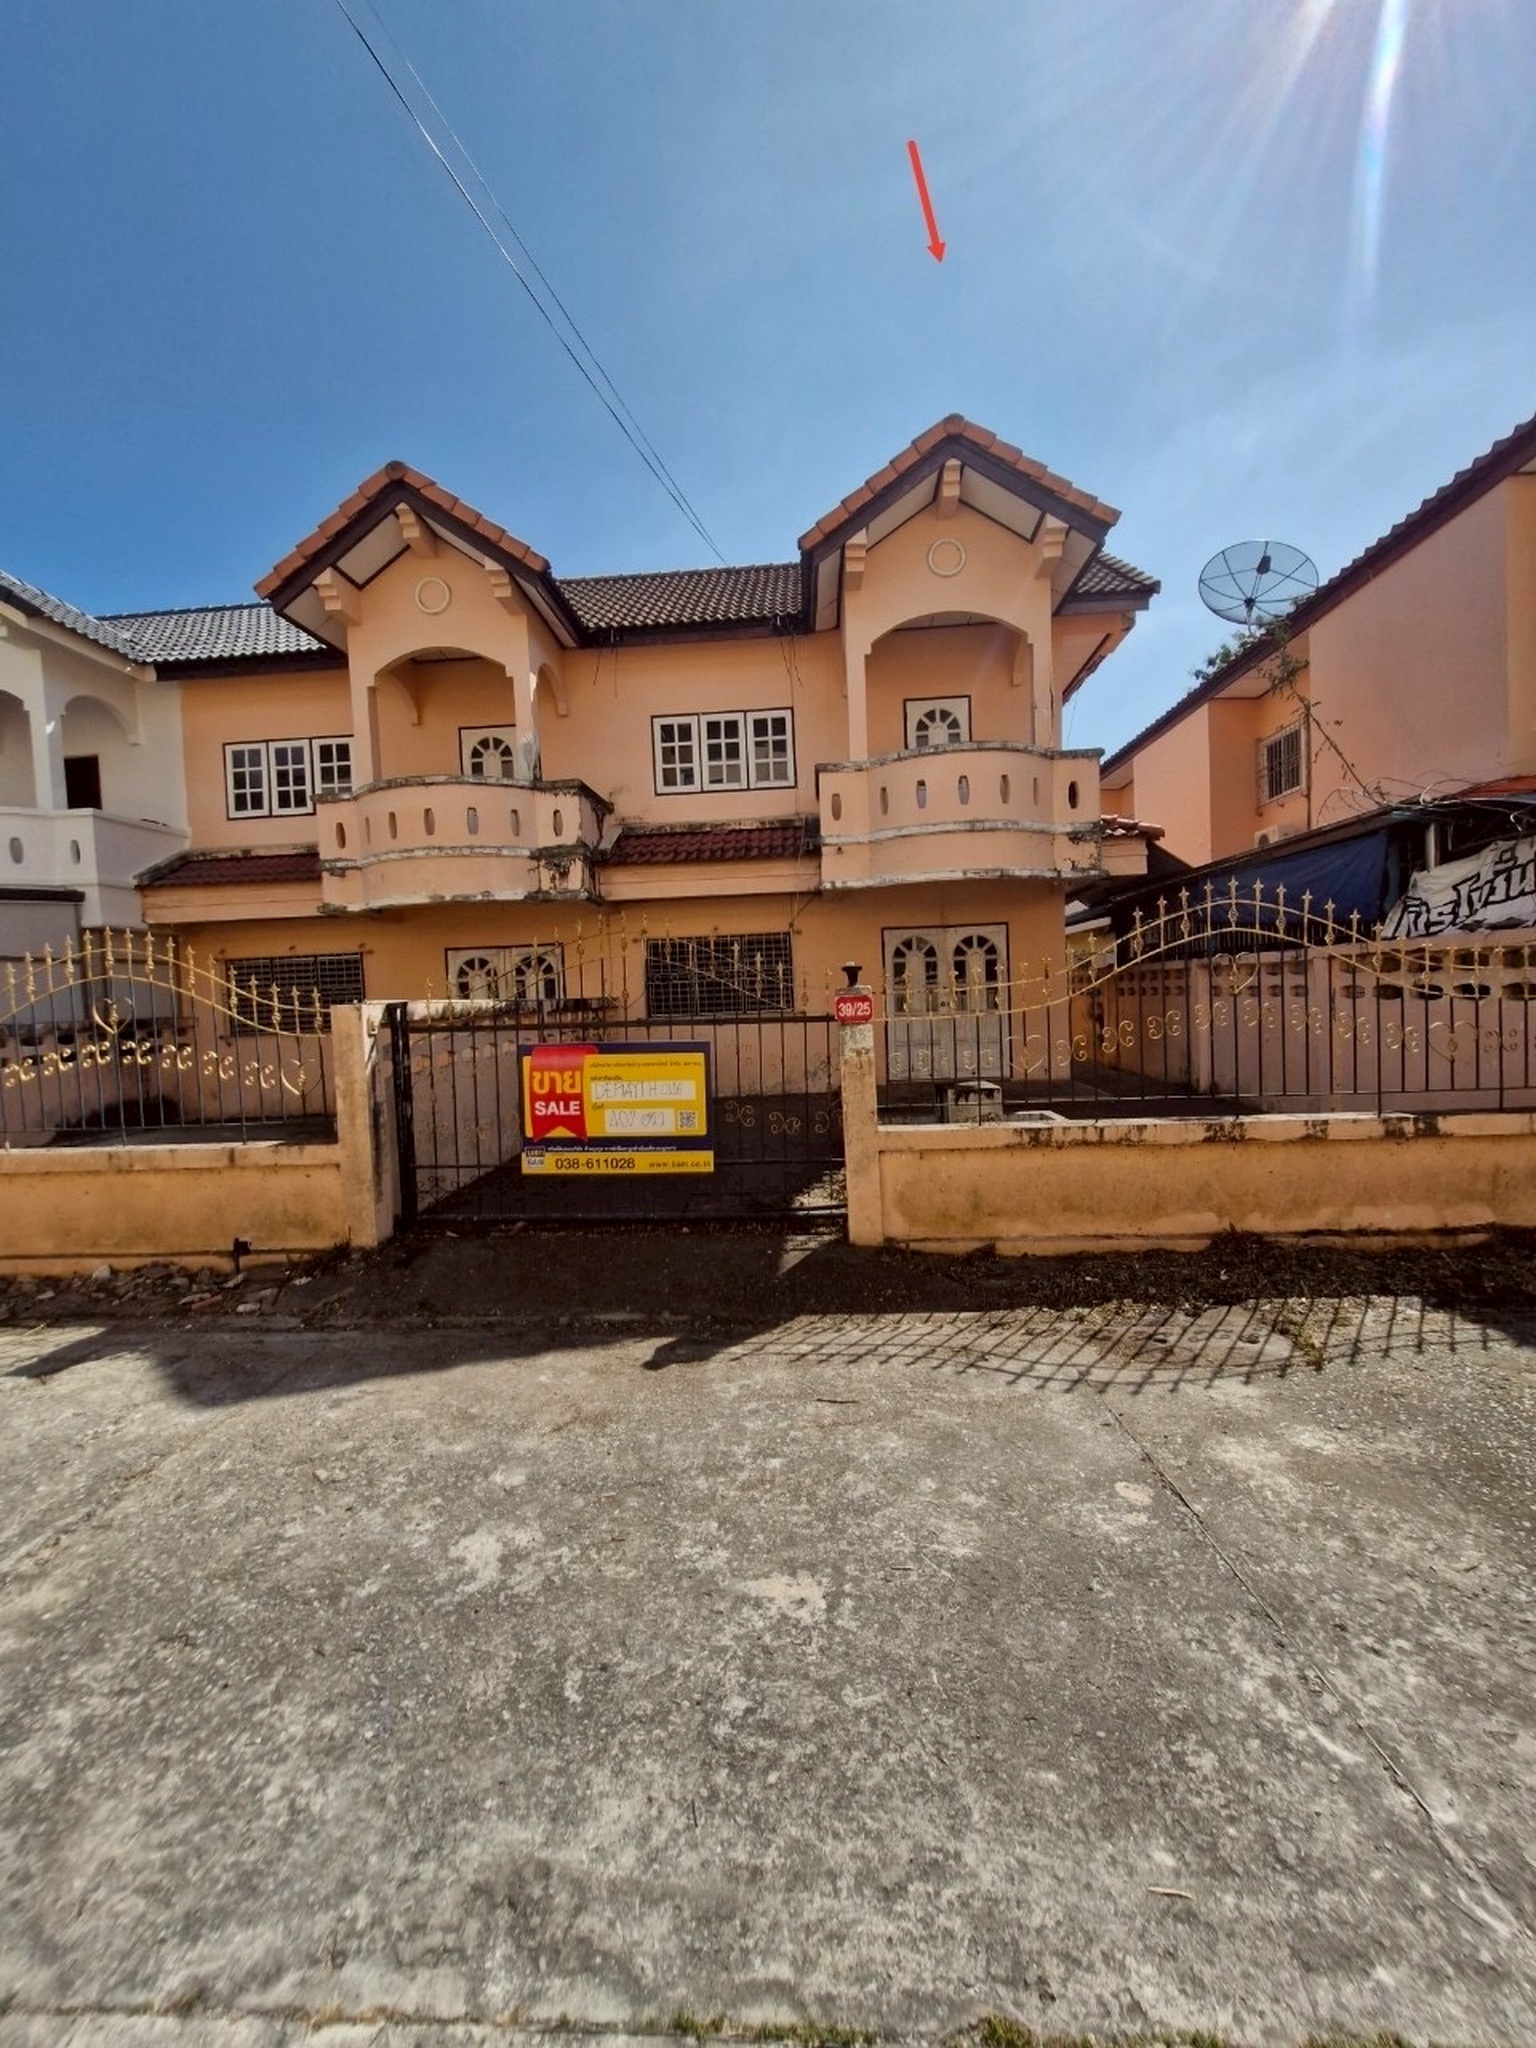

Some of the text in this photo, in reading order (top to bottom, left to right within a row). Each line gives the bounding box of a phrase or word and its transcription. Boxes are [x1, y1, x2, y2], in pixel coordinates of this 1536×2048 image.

[837, 1002, 872, 1017] 39/25
[532, 1070, 581, 1094] ขาย
[534, 1100, 581, 1116] SALE
[554, 1157, 636, 1170] 038-611028
